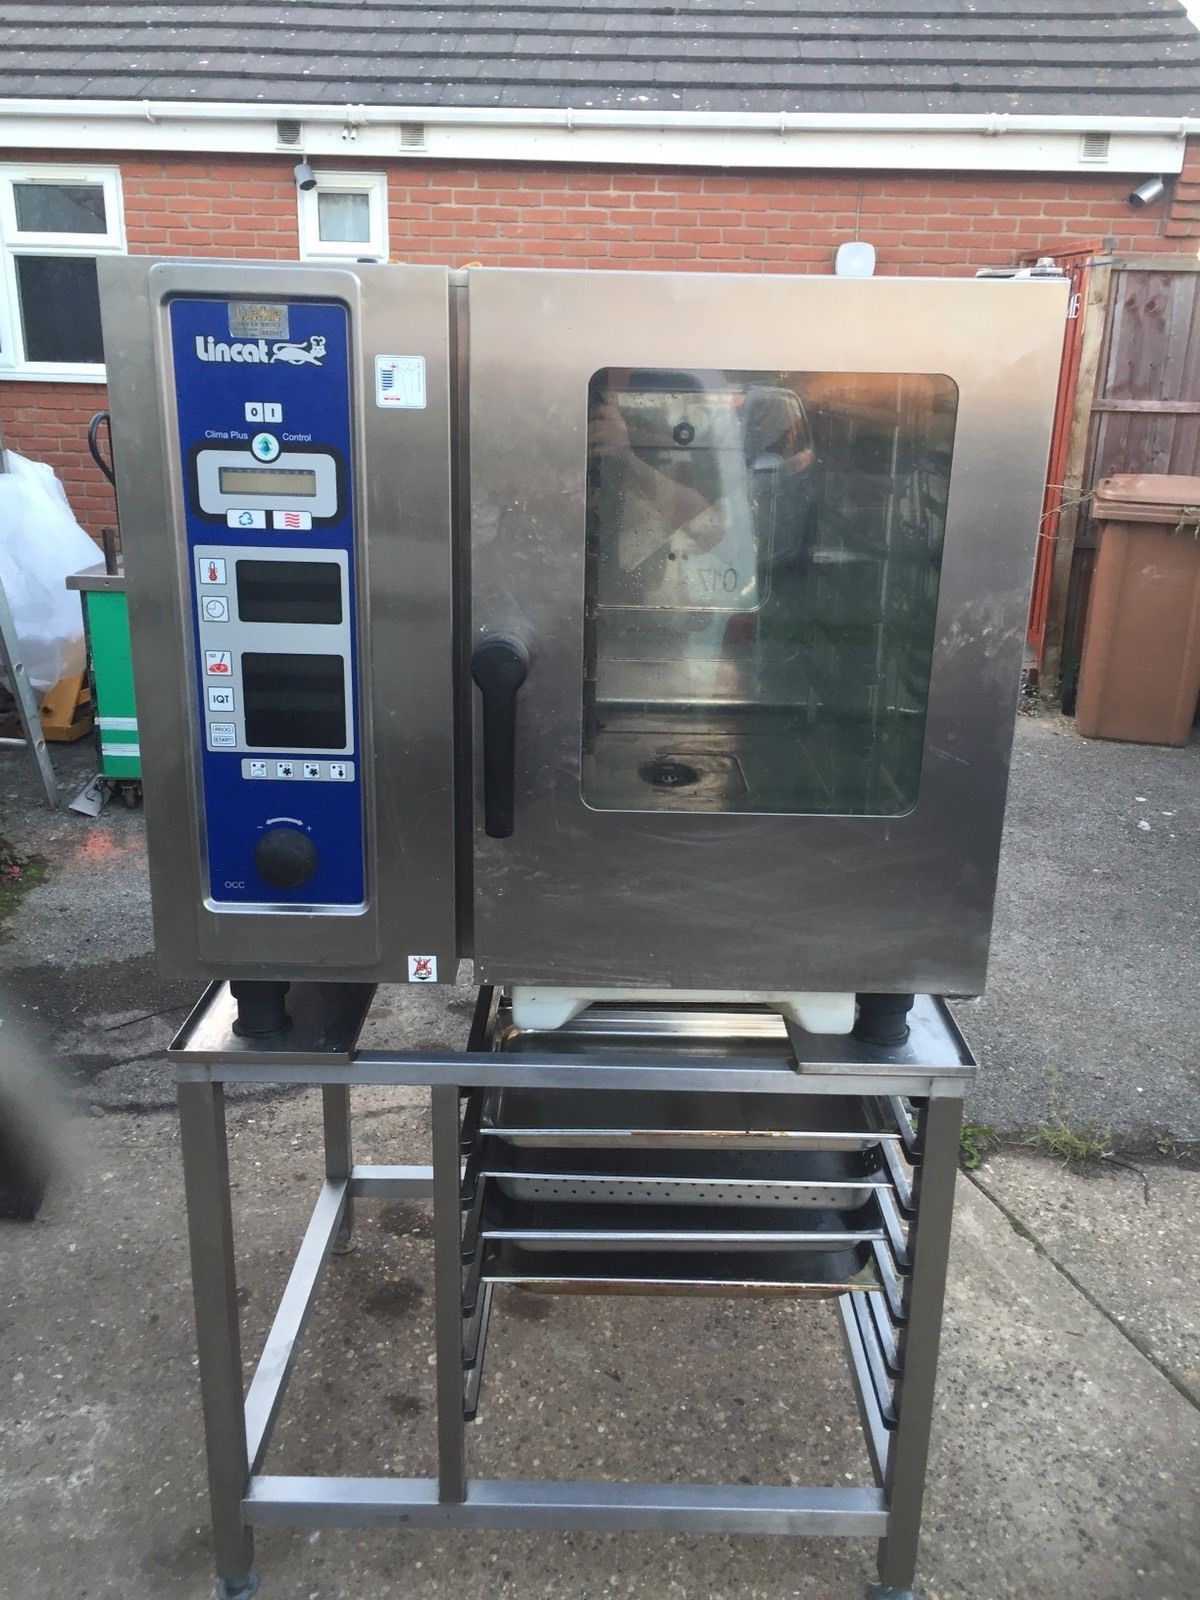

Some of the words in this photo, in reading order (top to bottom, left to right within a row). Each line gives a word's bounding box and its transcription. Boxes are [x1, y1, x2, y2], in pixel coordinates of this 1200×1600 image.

[195, 335, 269, 364] Lincat
[205, 430, 229, 439] Clima
[230, 430, 249, 440] Plus
[282, 432, 312, 442] Control
[213, 695, 229, 704] IQT
[215, 736, 233, 744] START
[224, 880, 246, 889] OCC
